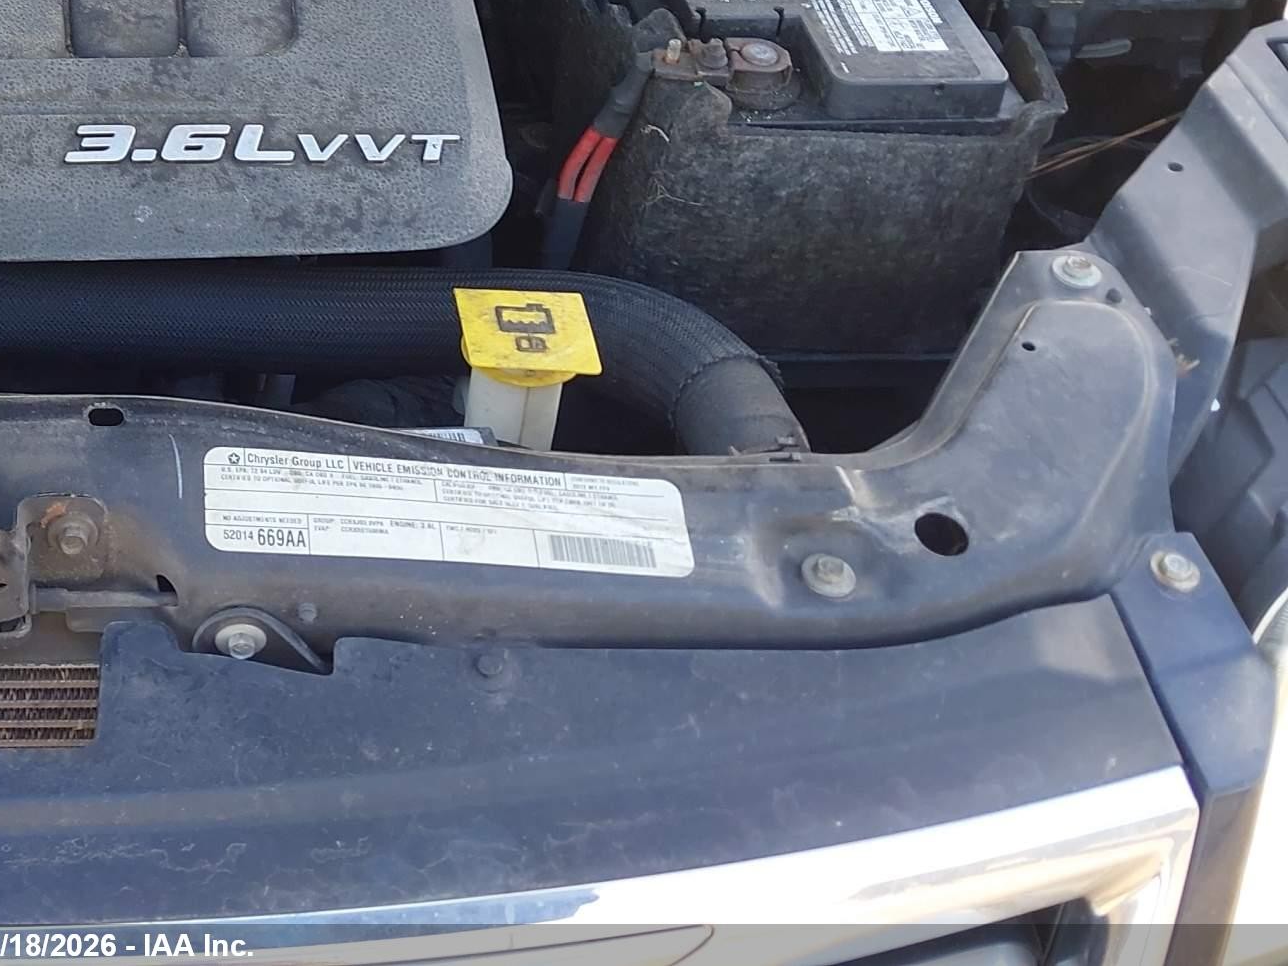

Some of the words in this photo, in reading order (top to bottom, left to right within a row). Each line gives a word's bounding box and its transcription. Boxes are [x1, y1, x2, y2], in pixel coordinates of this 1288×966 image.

[64, 123, 295, 163] 3.6L
[297, 134, 461, 163] VVT
[247, 453, 288, 465] Chrysler
[292, 456, 322, 468] Group
[325, 458, 344, 469] LLC
[352, 460, 393, 473] VEHICLE
[396, 463, 443, 477] EMISSION
[447, 468, 492, 482] CONTROL
[494, 472, 562, 487] INFORMATION
[223, 529, 254, 540] 52014
[257, 528, 307, 547] 669AA
